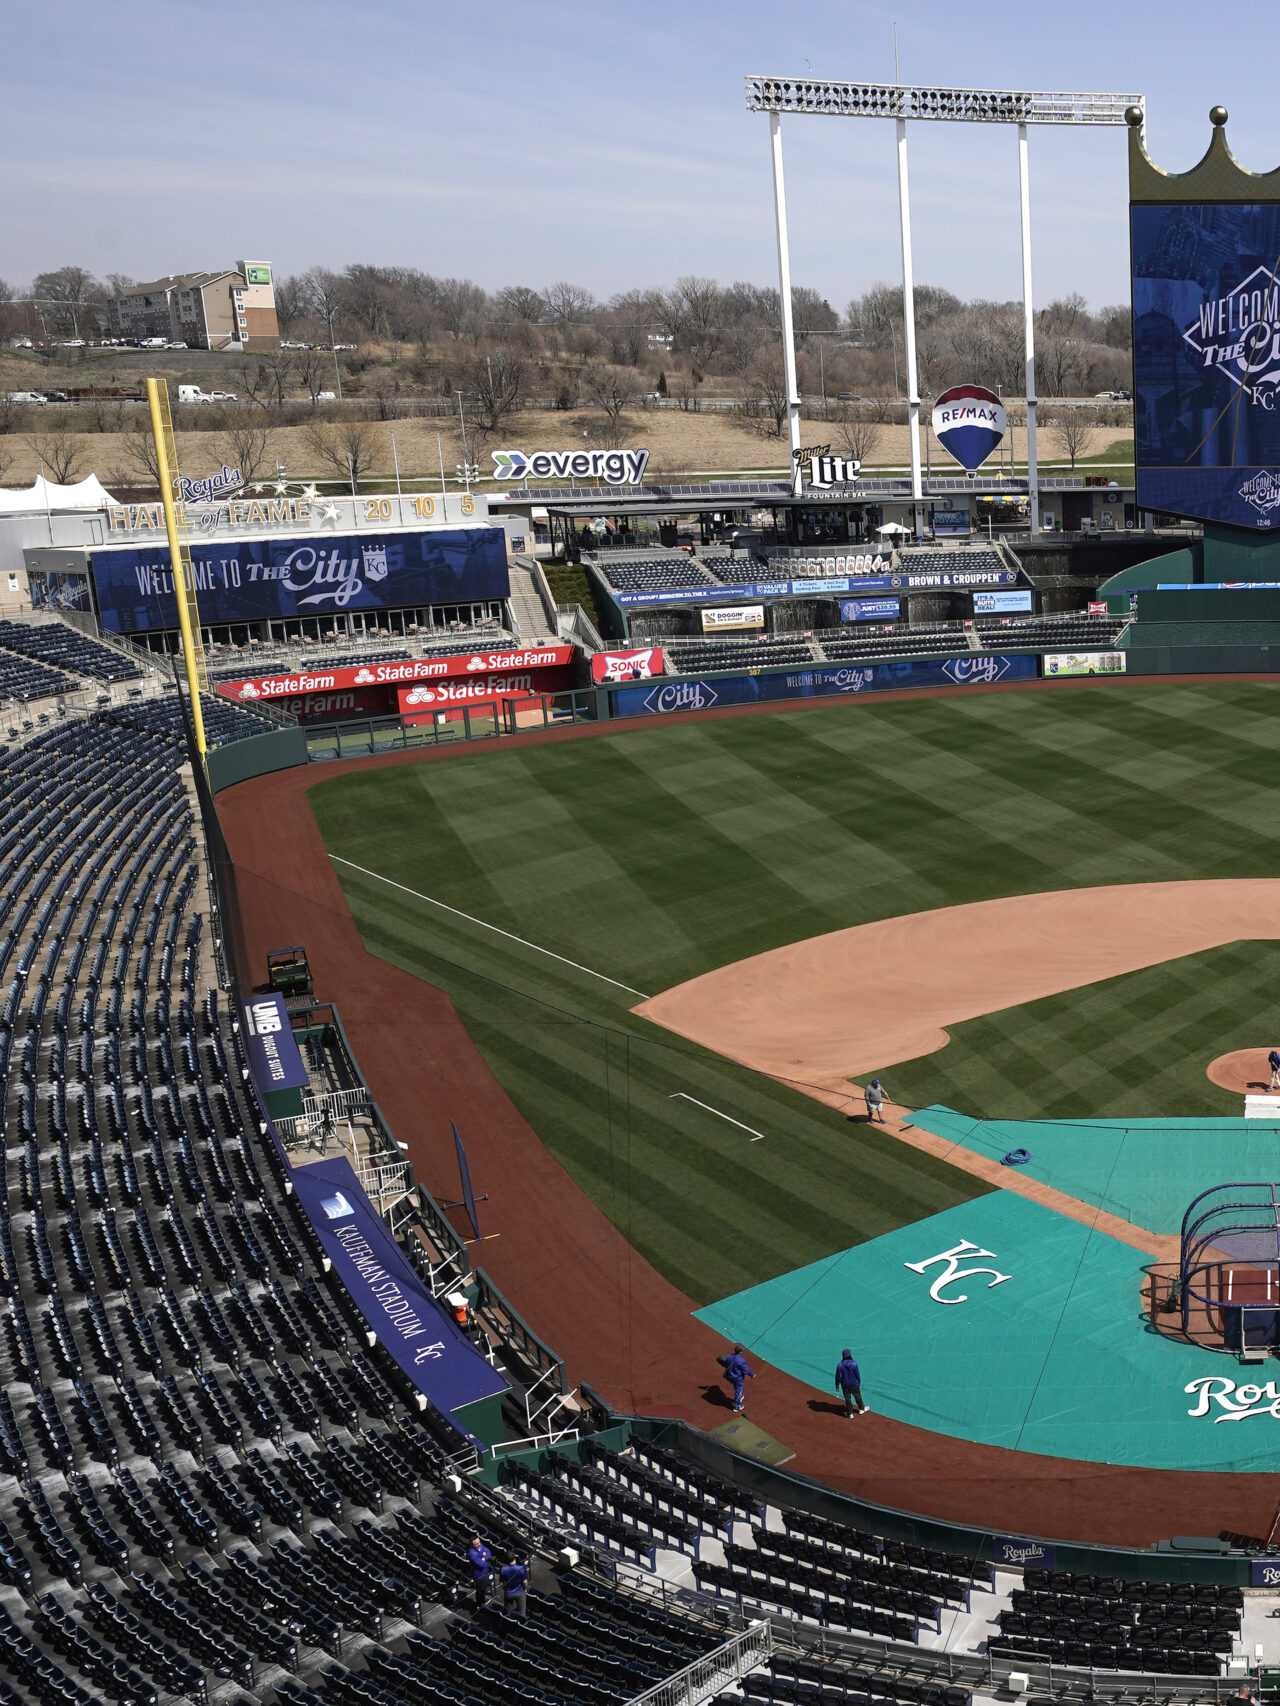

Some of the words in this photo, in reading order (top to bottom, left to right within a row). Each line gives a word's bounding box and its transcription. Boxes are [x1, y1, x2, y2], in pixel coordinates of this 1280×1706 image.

[1201, 340, 1245, 368] THE
[1250, 386, 1277, 411] KC
[941, 407, 998, 423] RE/MAX
[792, 443, 831, 467] Miller
[531, 450, 649, 485] evergy
[809, 455, 861, 490] Lite
[173, 465, 244, 505] Royals
[1243, 475, 1273, 494] WELCOME
[107, 503, 195, 531] HALL
[201, 505, 225, 531] of
[227, 499, 313, 525] FAME
[364, 498, 393, 521] 20
[412, 496, 436, 517] 10
[461, 494, 475, 515] 5
[135, 560, 216, 597] WELOME
[220, 558, 241, 588] TO
[246, 562, 291, 581] THE
[280, 546, 363, 607] City
[908, 575, 941, 587] BROWN
[943, 574, 951, 585] &
[953, 573, 1000, 585] CROUPPEN
[609, 659, 647, 674] SONIC
[786, 674, 814, 688] WELCOME
[815, 673, 823, 685] TO
[835, 668, 864, 691] City
[270, 691, 355, 716] ateFarm
[656, 681, 705, 712] City
[252, 1001, 282, 1034] UMB
[262, 1035, 279, 1058] DUGOUT
[268, 1059, 285, 1080] SUITES
[333, 1224, 390, 1284] KAUFFMAN
[371, 1281, 427, 1340] STADIUM
[904, 1238, 1013, 1305] KC
[1003, 1543, 1045, 1563] Royals
